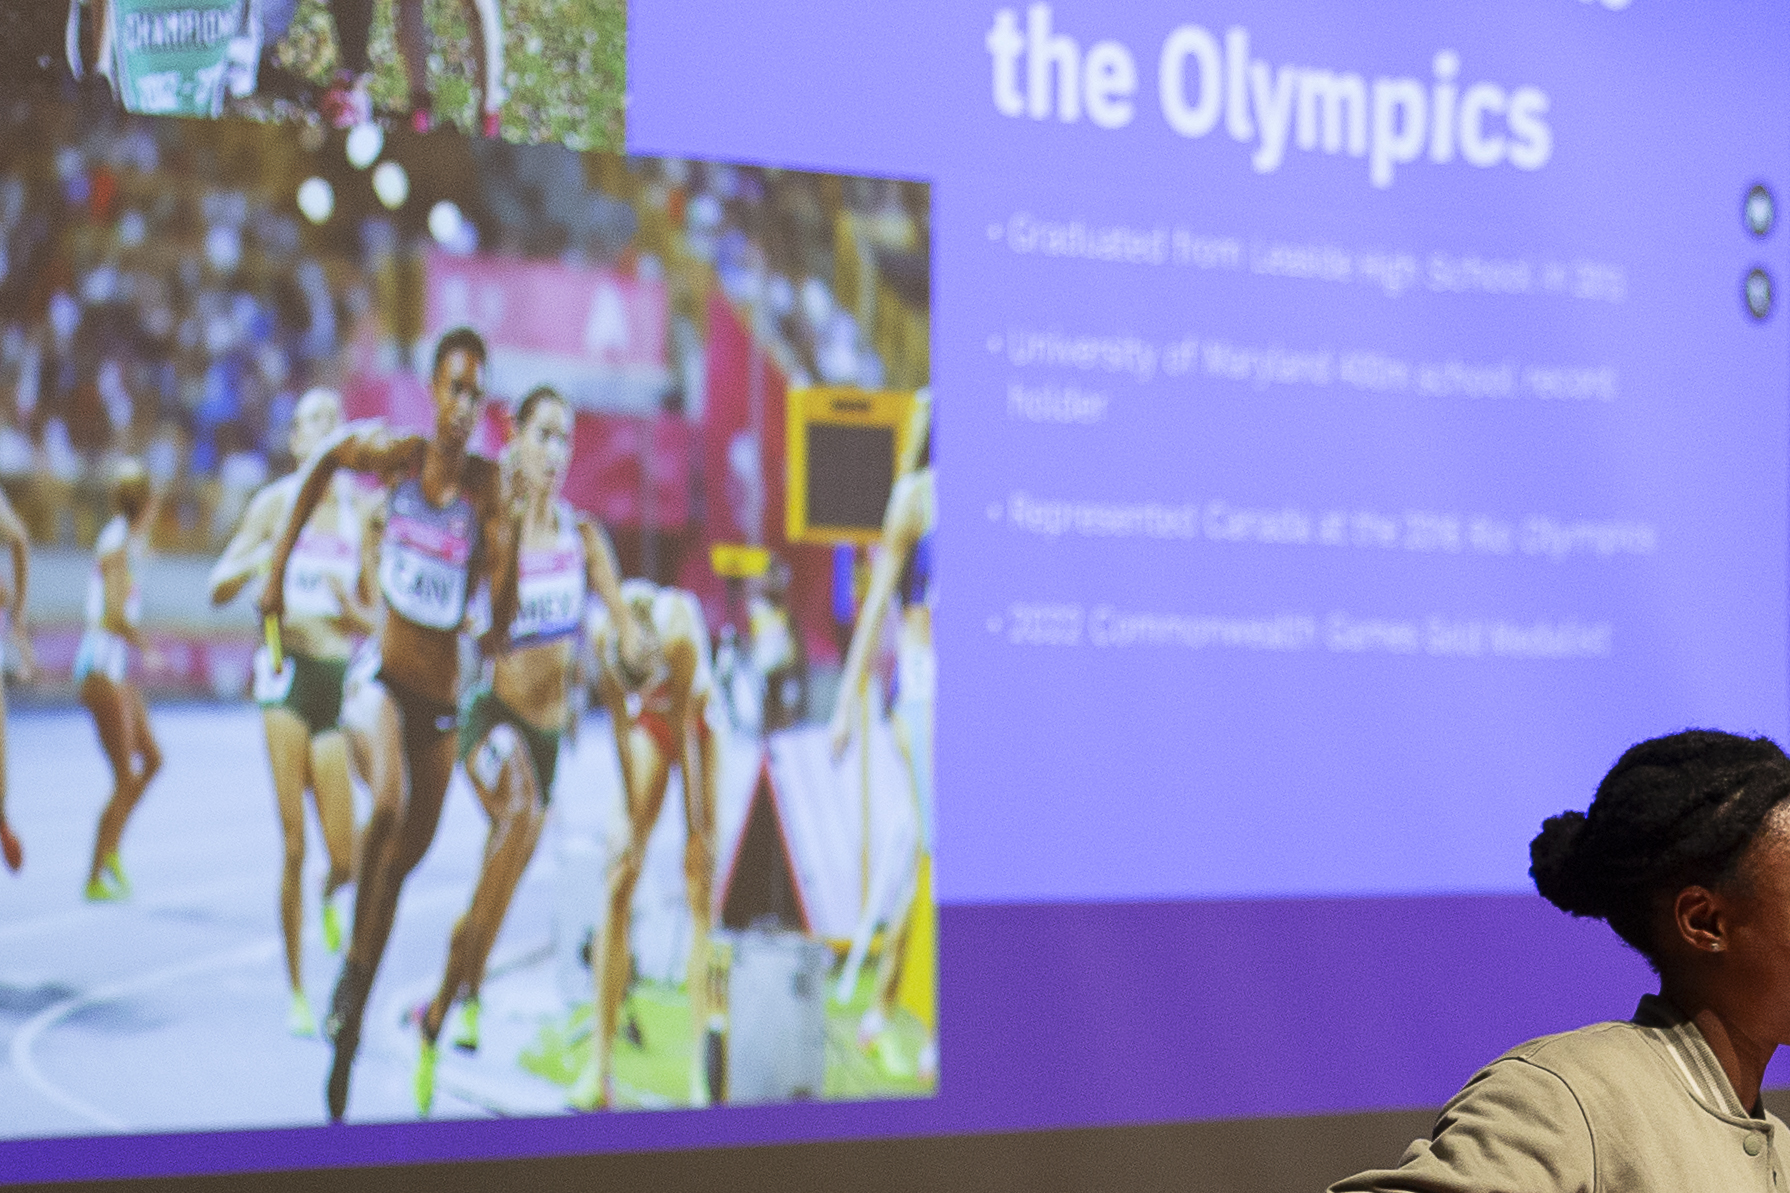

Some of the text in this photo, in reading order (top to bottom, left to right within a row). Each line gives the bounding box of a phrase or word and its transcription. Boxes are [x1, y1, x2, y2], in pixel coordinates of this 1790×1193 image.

[986, 3, 1554, 188] the Olympics
[1007, 212, 1166, 265] Graduated
[1172, 229, 1241, 270] from
[1358, 251, 1416, 298] High
[1424, 250, 1530, 295] School
[1007, 328, 1157, 384] University
[1162, 334, 1200, 377] of
[1203, 341, 1332, 391] Maryland
[1417, 359, 1513, 399] school
[1522, 365, 1618, 404] record
[1007, 383, 1109, 425] holder
[1007, 491, 1197, 540] Represented
[1203, 499, 1312, 546] Canada
[1319, 510, 1346, 546] at
[1349, 509, 1399, 550] the
[1088, 604, 1317, 651] Commonwealth
[1324, 610, 1418, 654] Games
